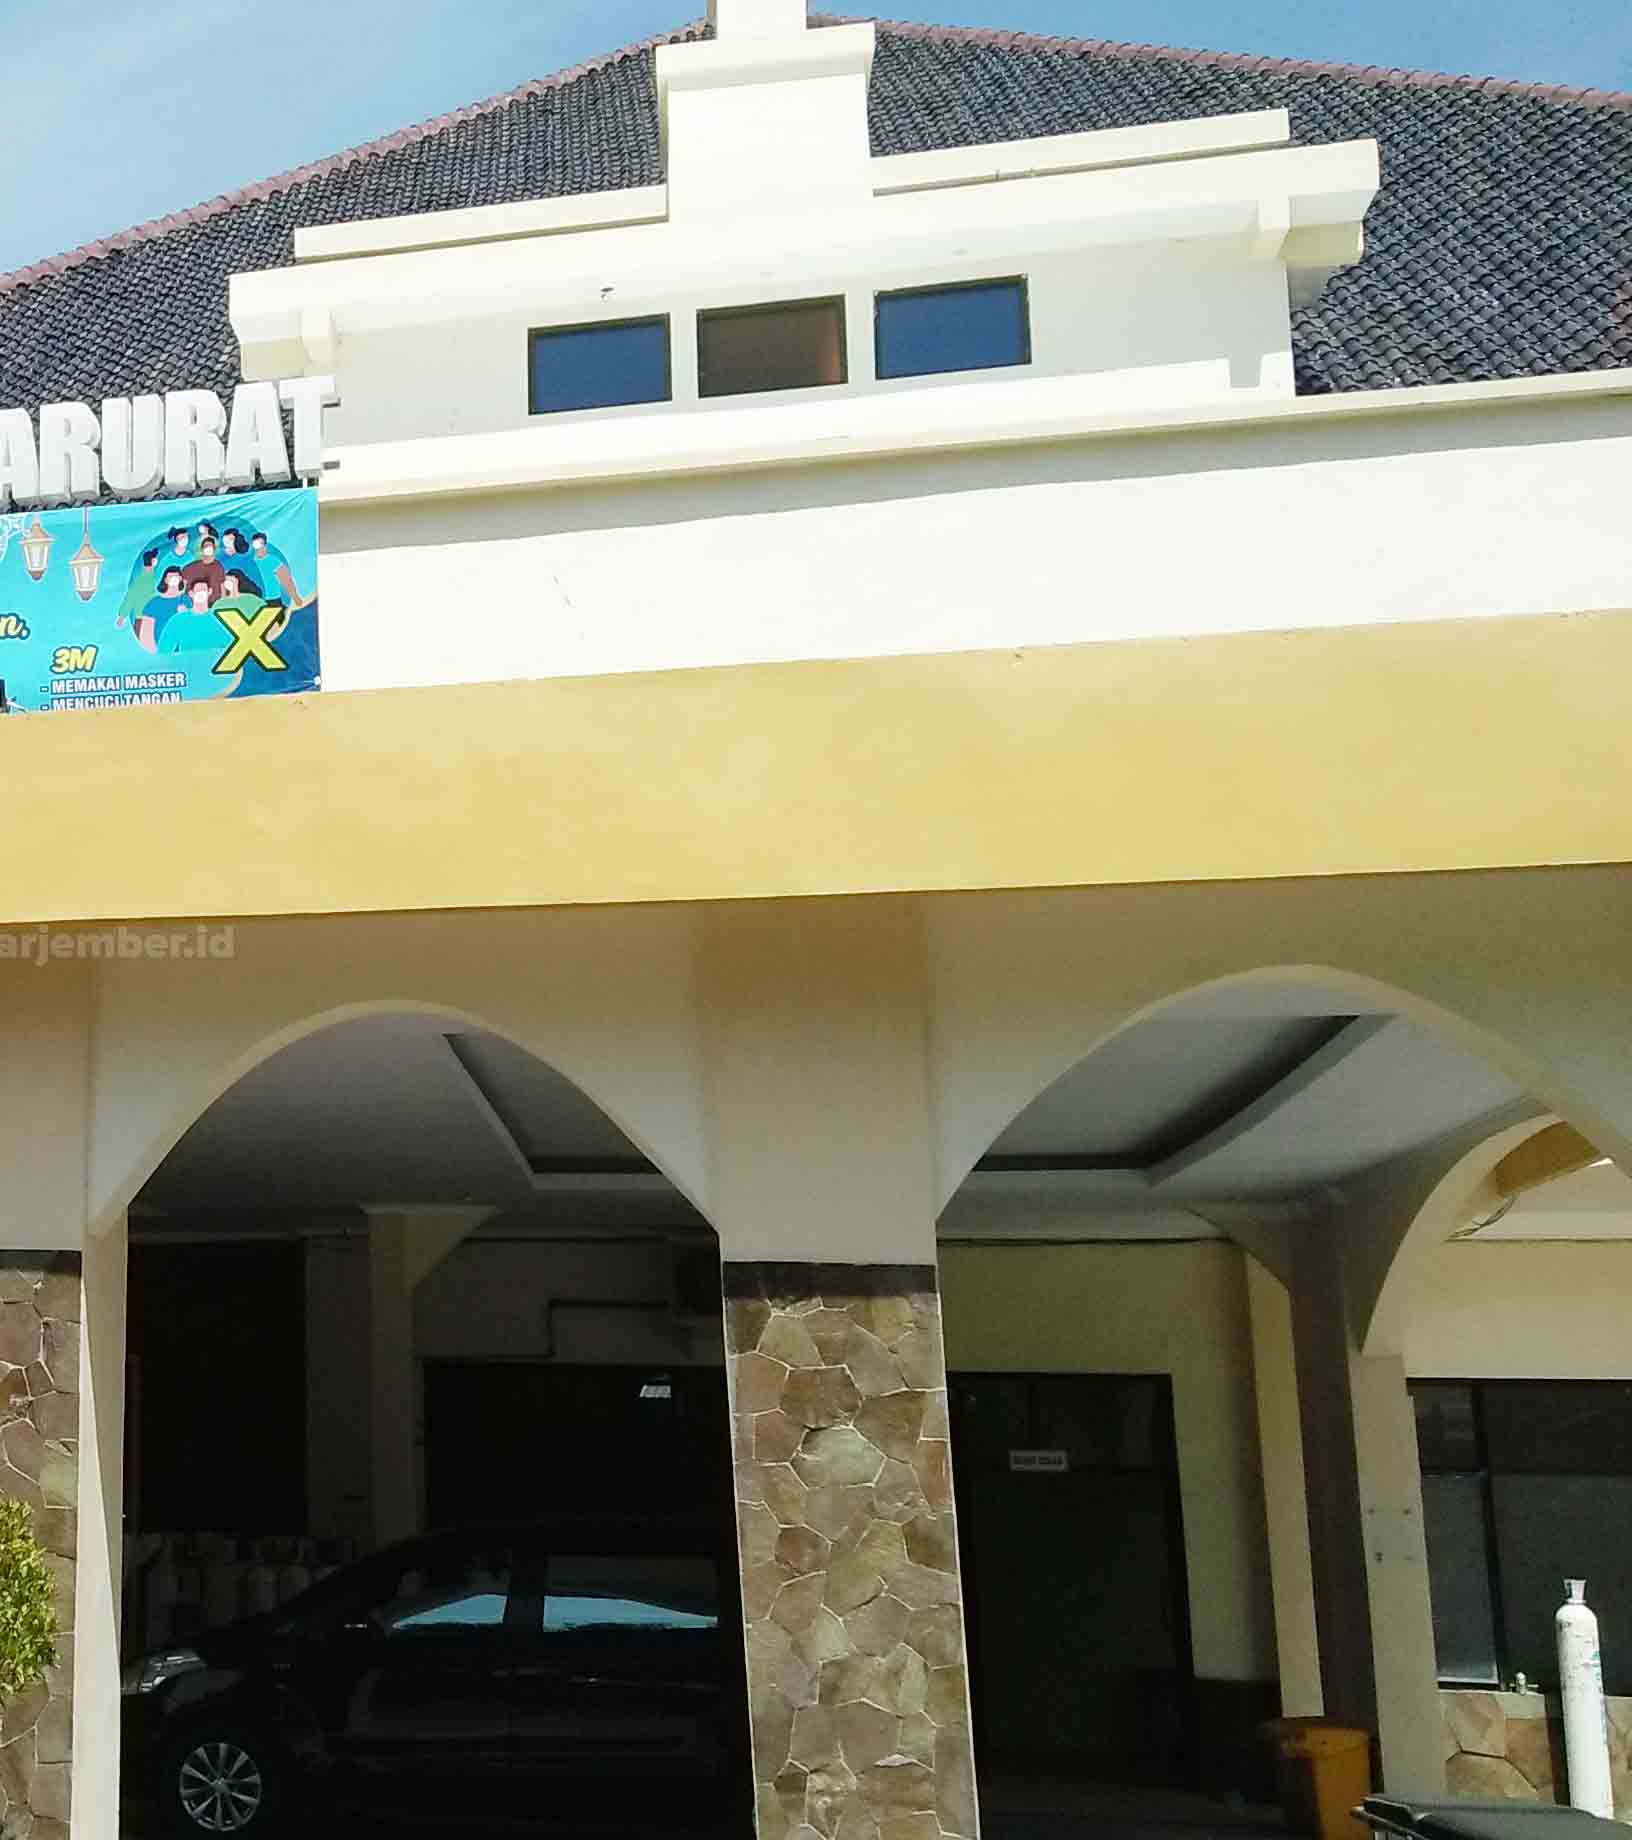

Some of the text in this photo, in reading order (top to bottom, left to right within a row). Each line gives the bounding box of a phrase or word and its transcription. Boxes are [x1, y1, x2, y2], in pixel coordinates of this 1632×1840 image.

[50, 644, 97, 674] 3M
[52, 672, 186, 695] MEMAKAI MASKER
